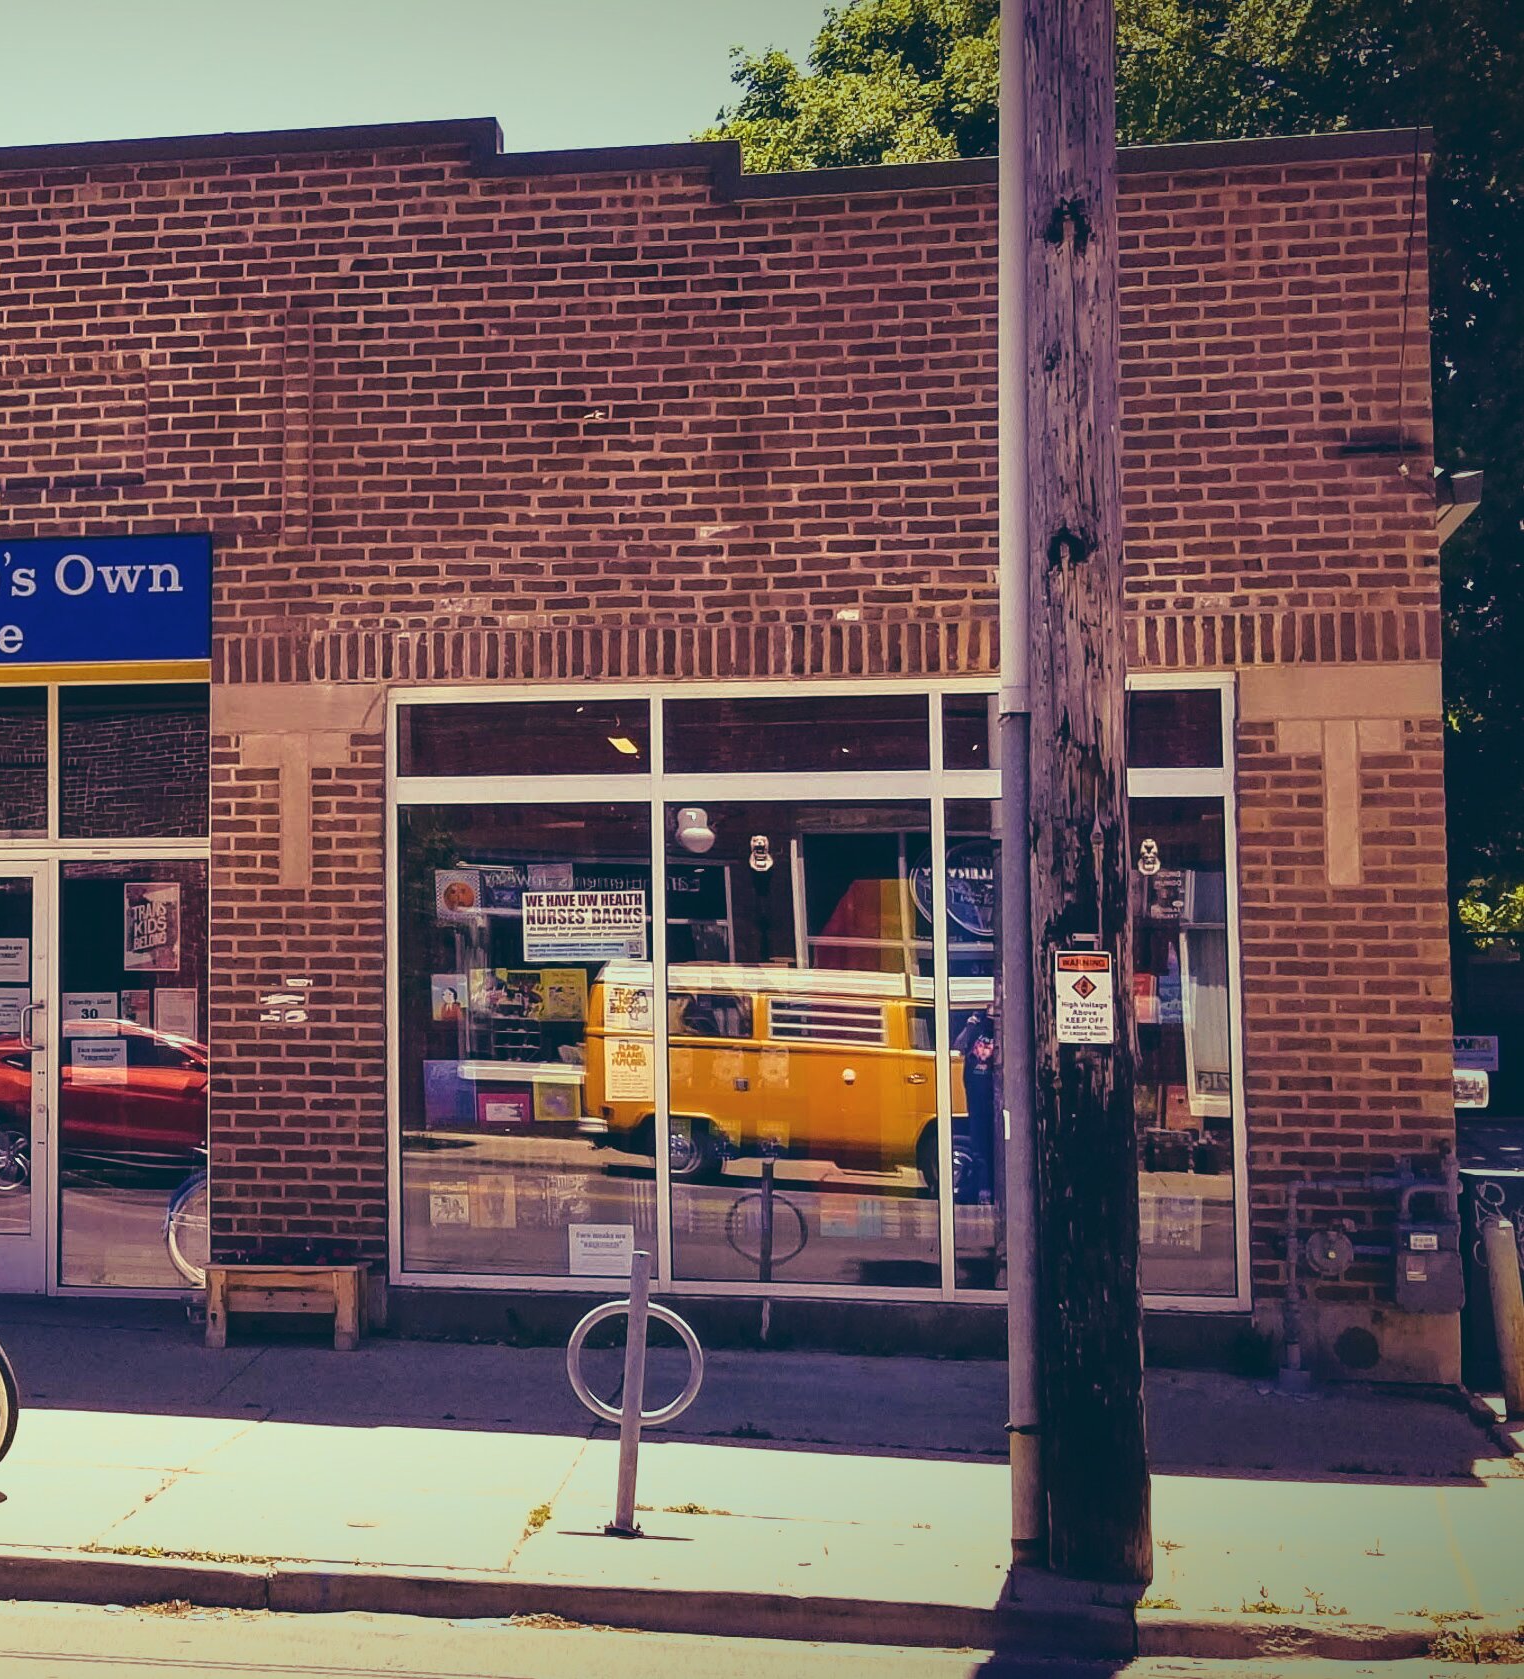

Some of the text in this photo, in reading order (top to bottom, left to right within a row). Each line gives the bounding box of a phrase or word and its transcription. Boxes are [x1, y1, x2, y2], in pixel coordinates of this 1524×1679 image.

[54, 554, 184, 596] Own
[525, 893, 642, 908] WE HAVE UW HEALTH
[132, 902, 167, 920] TRANS
[526, 907, 643, 926] NURSES' BACKS
[133, 917, 167, 937] KIDS
[133, 932, 167, 951] BELONG
[1062, 959, 1107, 968] WARNING
[81, 1008, 98, 1019] 30
[1062, 1001, 1108, 1010] High Voltage
